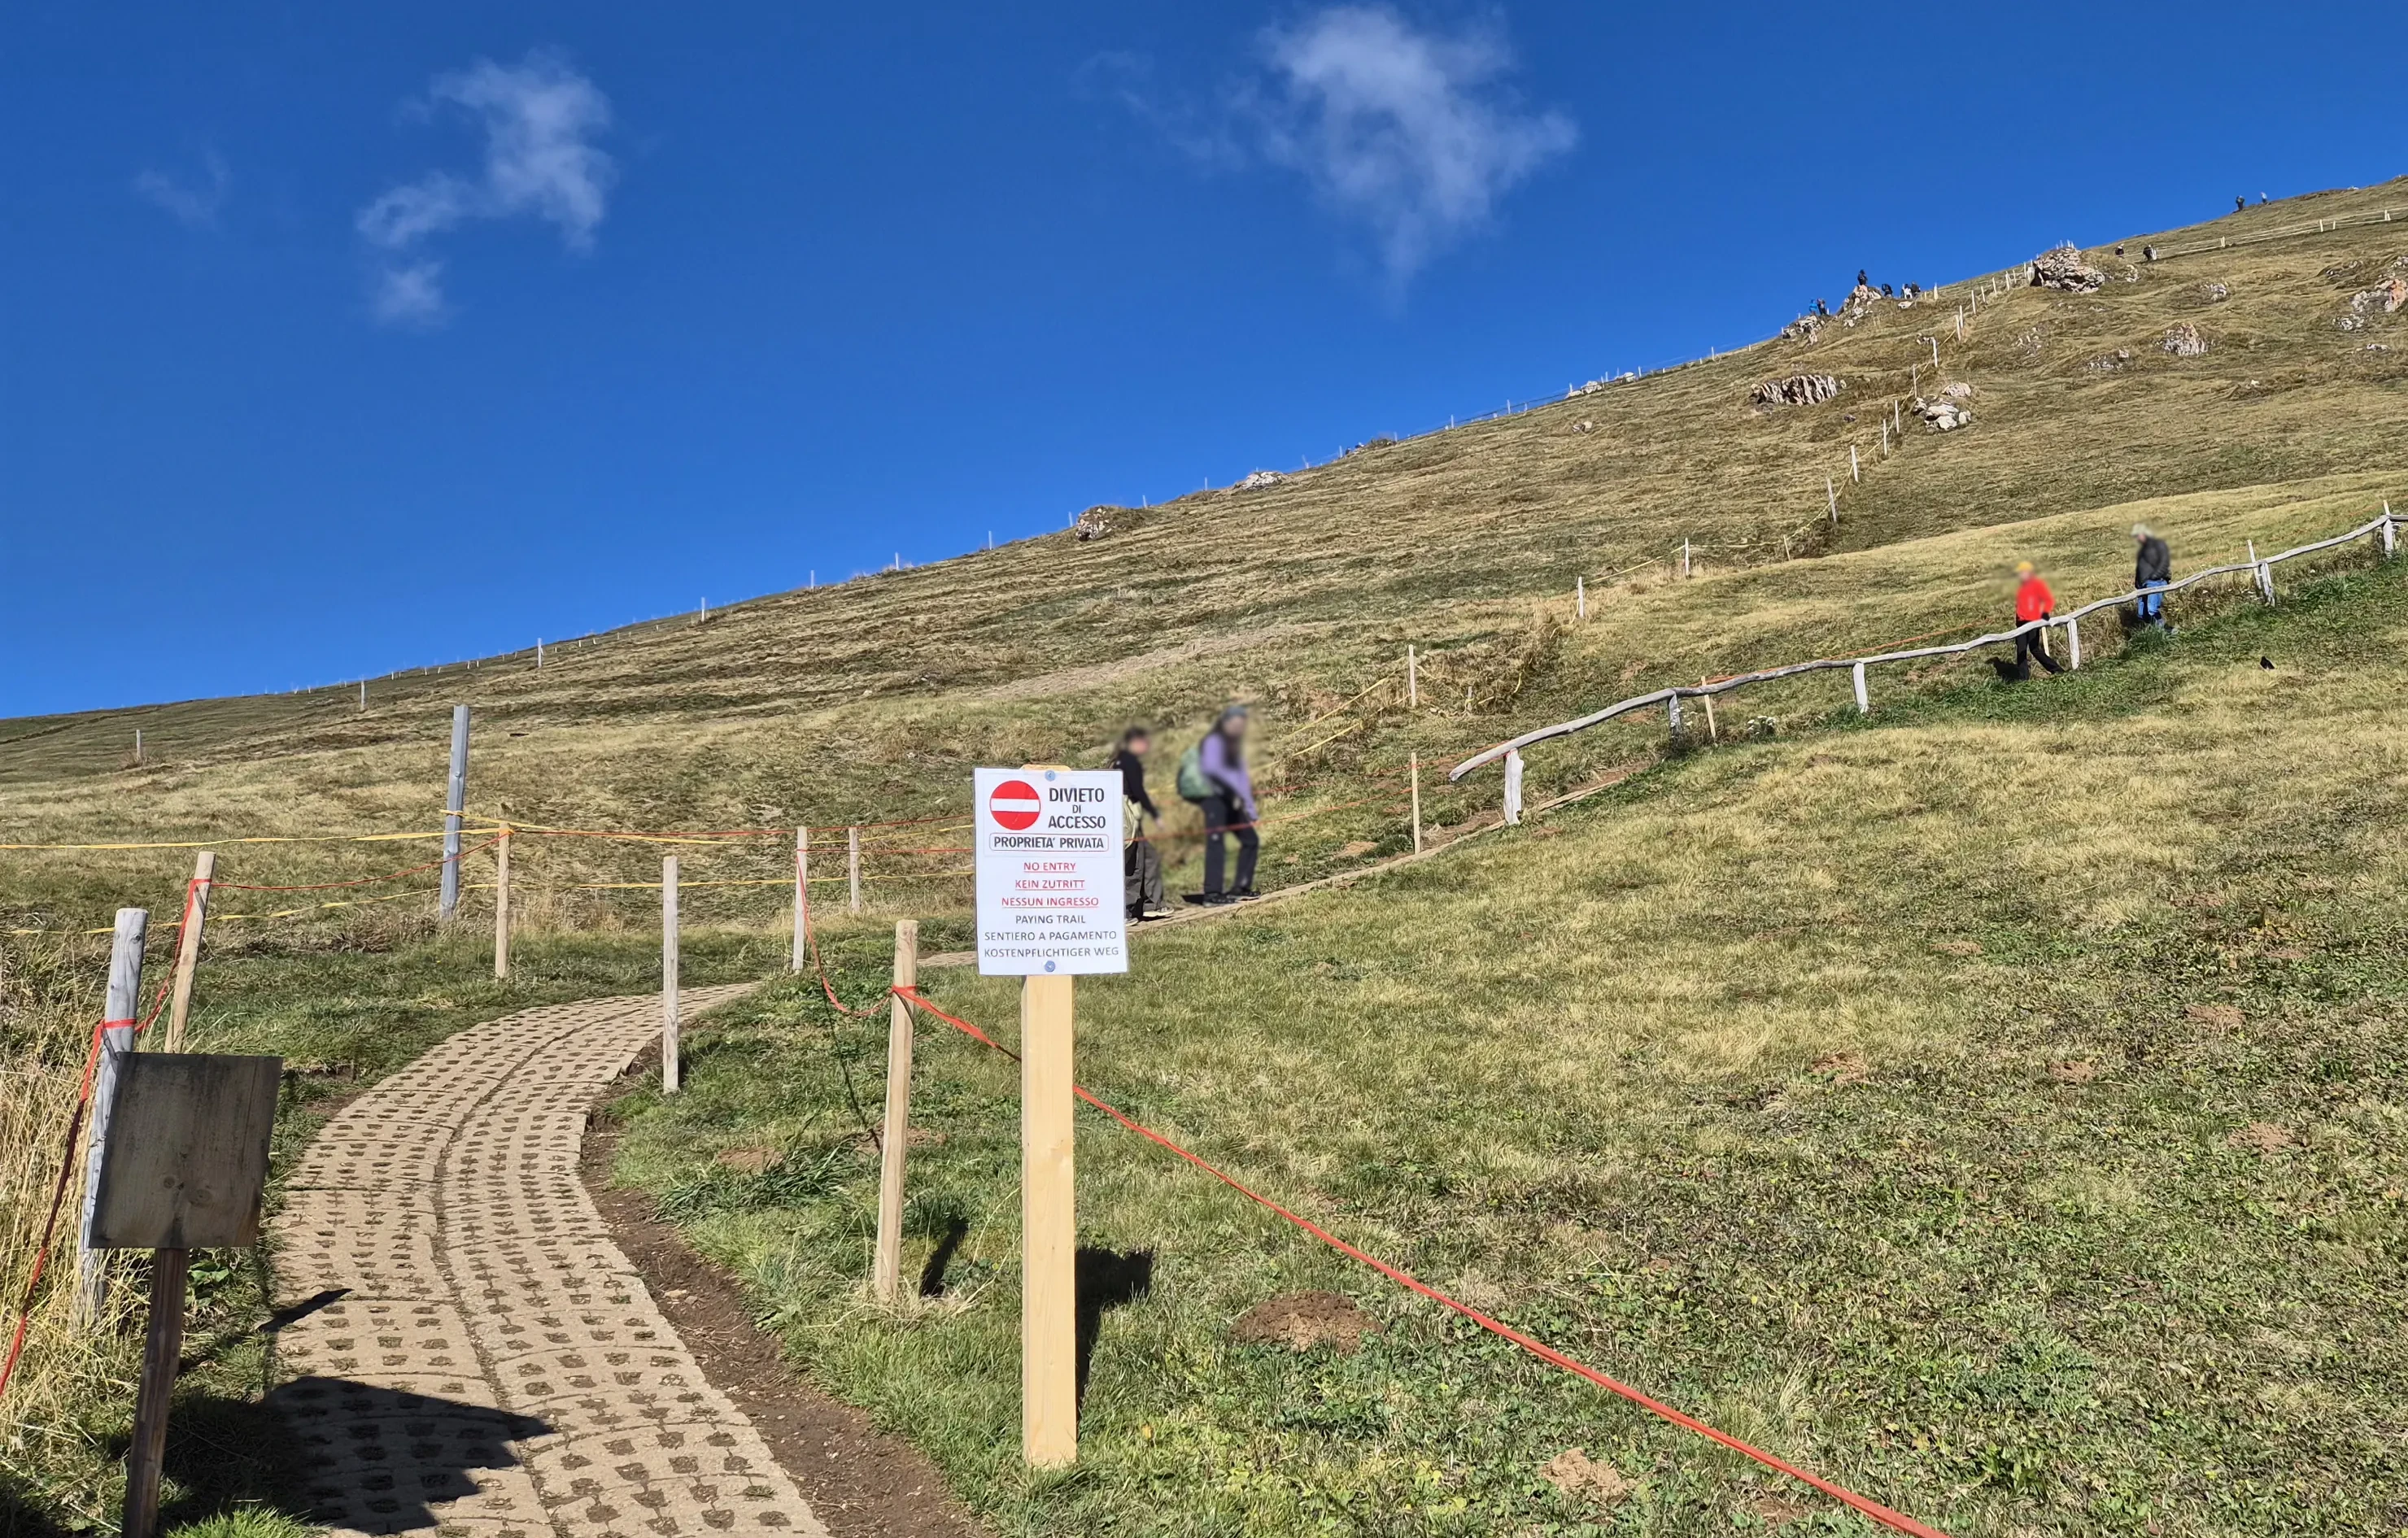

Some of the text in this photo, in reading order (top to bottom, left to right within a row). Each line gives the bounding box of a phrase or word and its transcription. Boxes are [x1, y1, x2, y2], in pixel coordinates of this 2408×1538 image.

[1049, 787, 1104, 803] DIVIETO
[1072, 804, 1081, 813] DI
[1049, 816, 1106, 829] ACCESSO
[1060, 838, 1104, 848] PRIVATA
[1023, 862, 1076, 871] NO ENTRY
[1015, 880, 1085, 888] KEIN ZUTRITT
[1001, 898, 1098, 906] NESSUN INGRESSO
[1015, 915, 1086, 923] PAYING TRAIL
[984, 931, 1117, 940] SENTIERO A PAGAMENTO
[984, 948, 1119, 957] KOSTENPFLICHTIGER WEG
